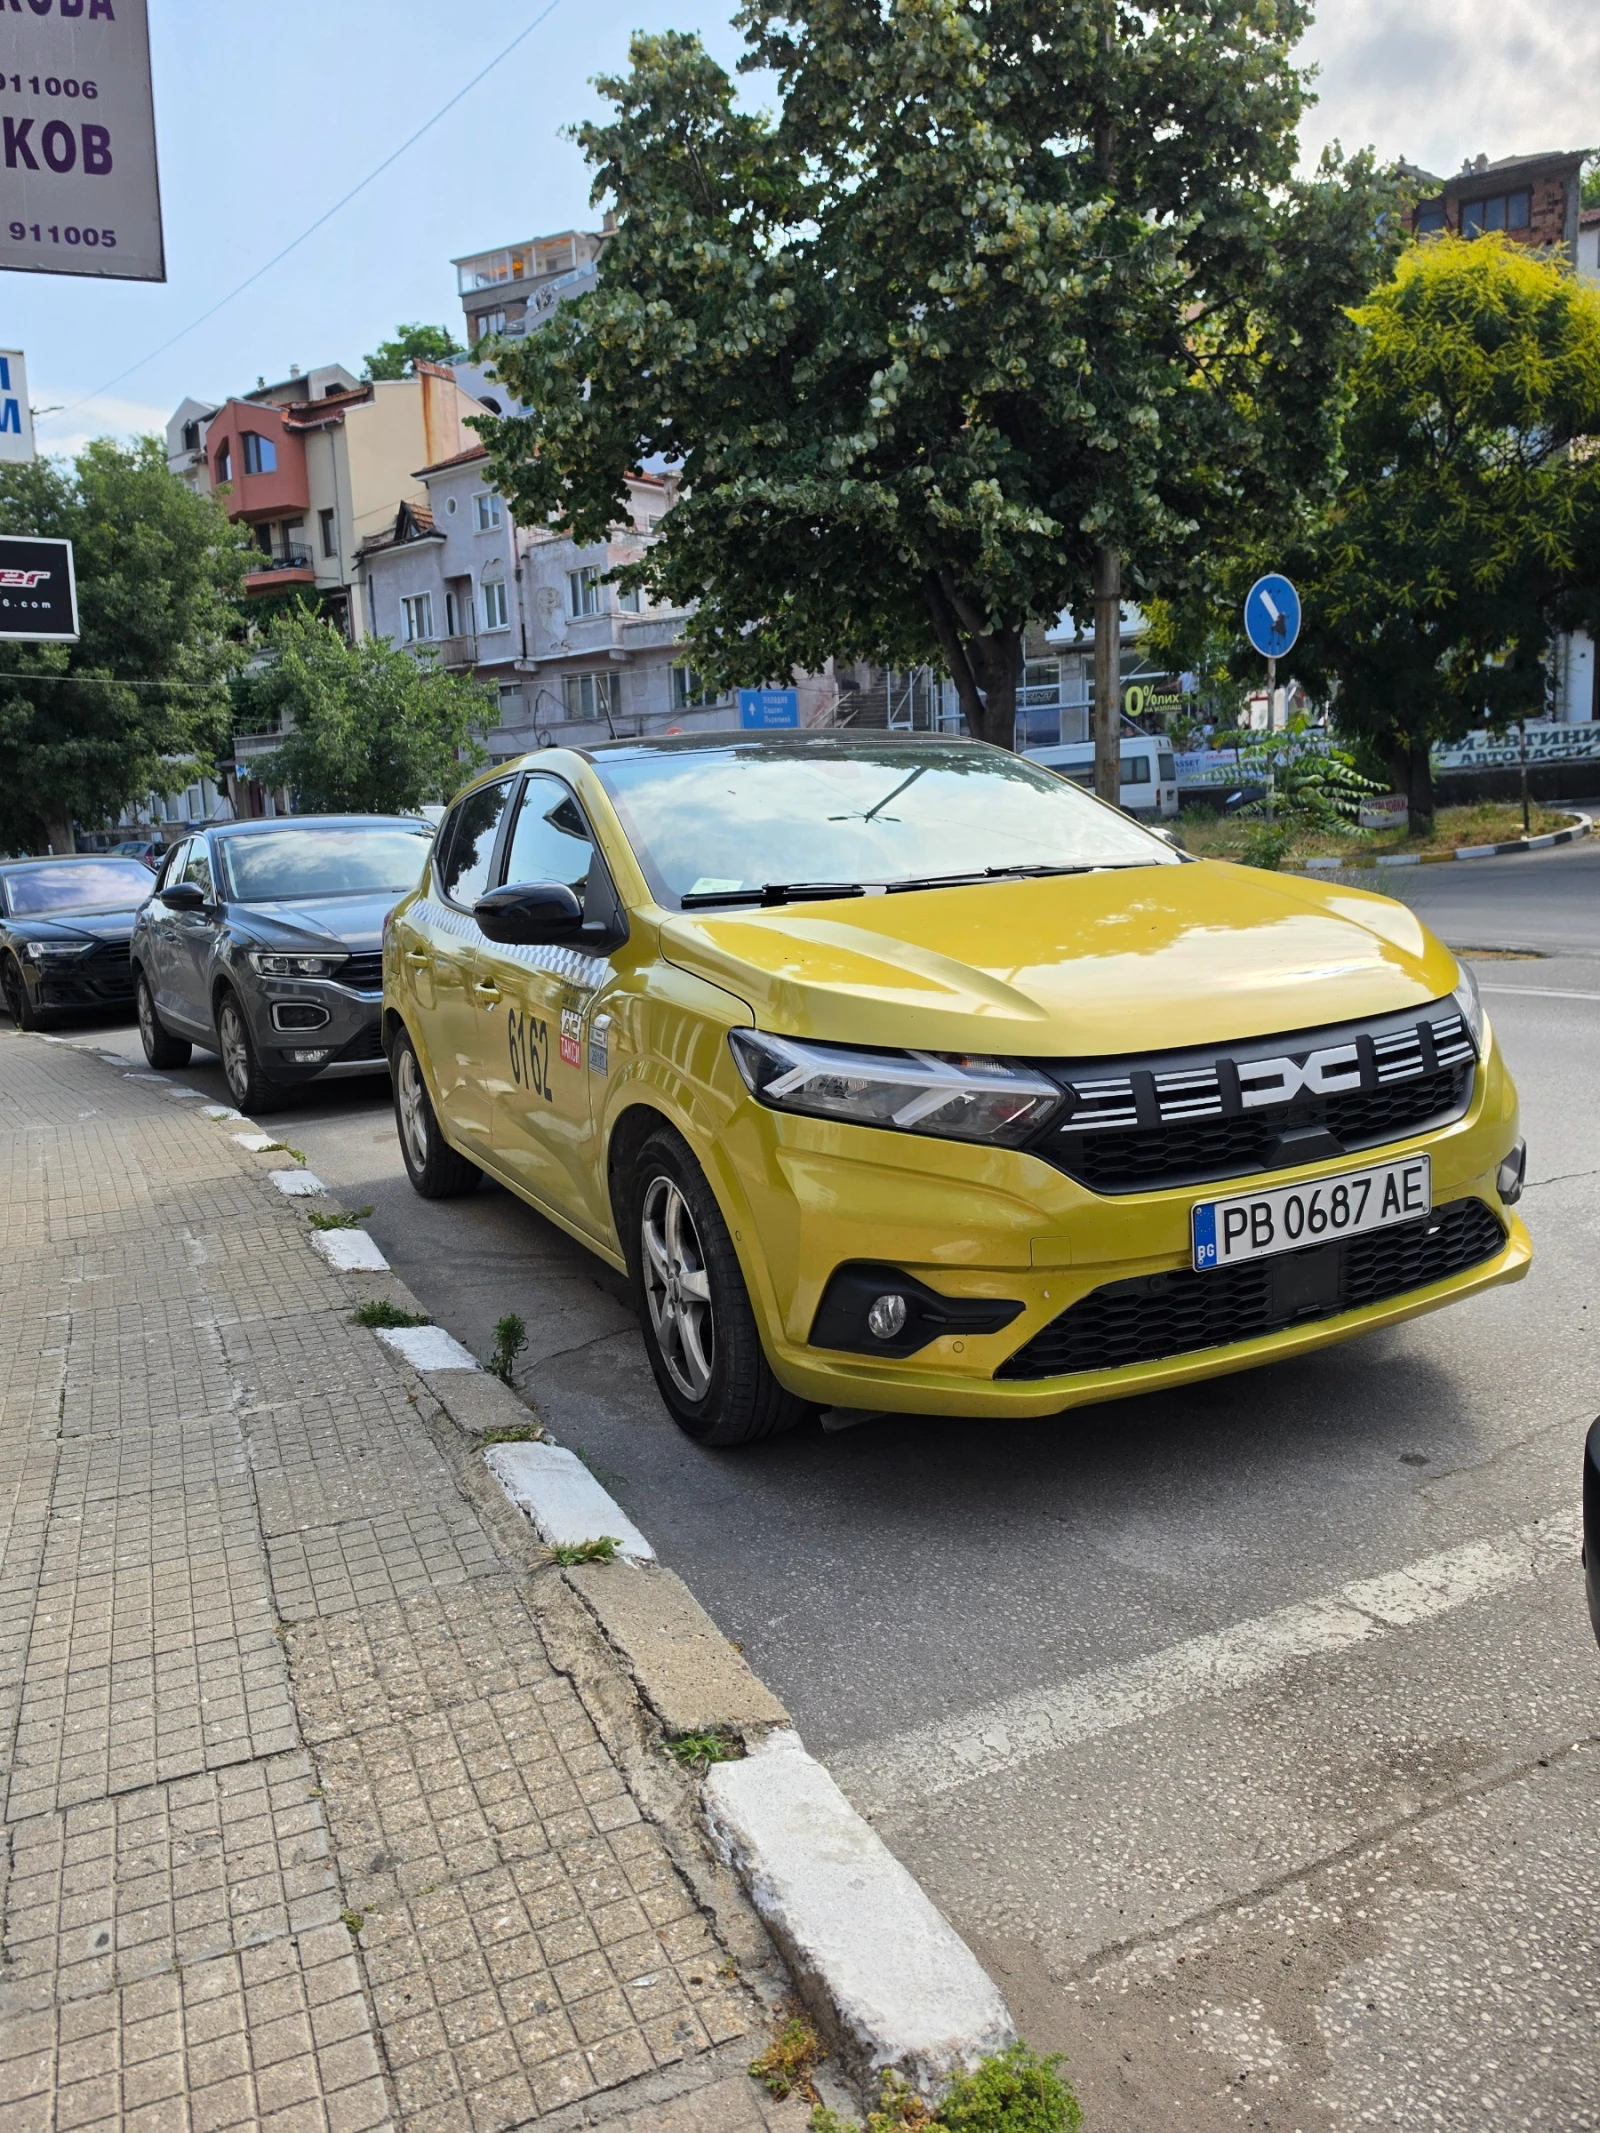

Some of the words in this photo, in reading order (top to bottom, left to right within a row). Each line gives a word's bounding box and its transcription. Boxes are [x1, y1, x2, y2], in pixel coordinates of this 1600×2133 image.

[9, 221, 116, 247] 911005
[508, 1008, 553, 1103] 6162
[1223, 1201, 1275, 1256] PB
[1284, 1178, 1373, 1240] 0687
[1380, 1165, 1424, 1219] AE
[1197, 1243, 1215, 1259] BG
